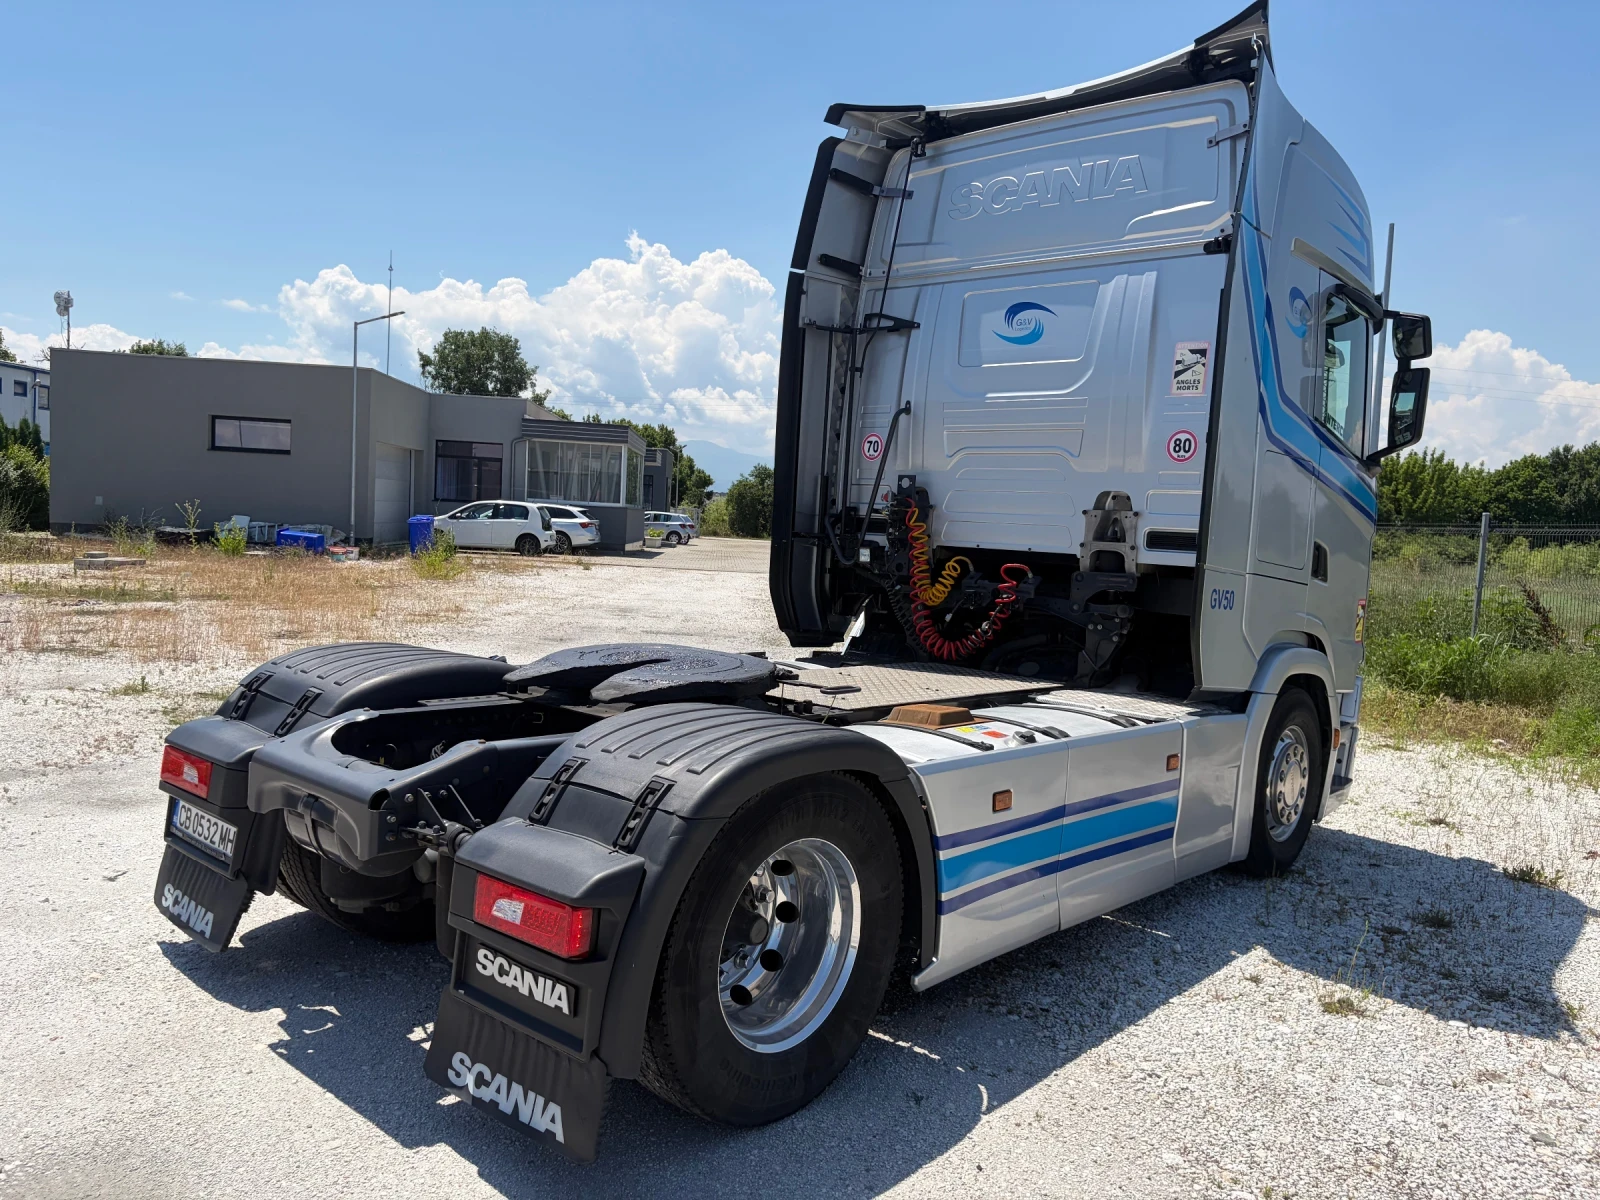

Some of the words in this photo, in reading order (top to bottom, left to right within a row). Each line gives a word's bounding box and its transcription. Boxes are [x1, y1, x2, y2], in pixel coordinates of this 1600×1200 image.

[948, 154, 1149, 221] SCANIA
[867, 440, 879, 453] 70
[1173, 438, 1192, 453] 80
[1210, 588, 1235, 610] GV50
[178, 804, 192, 830] CB
[192, 812, 219, 845] 0532
[218, 824, 236, 855] MH
[161, 883, 214, 939] SCANIA
[475, 948, 570, 1015] SCANIA
[447, 1051, 565, 1144] SCANIA
